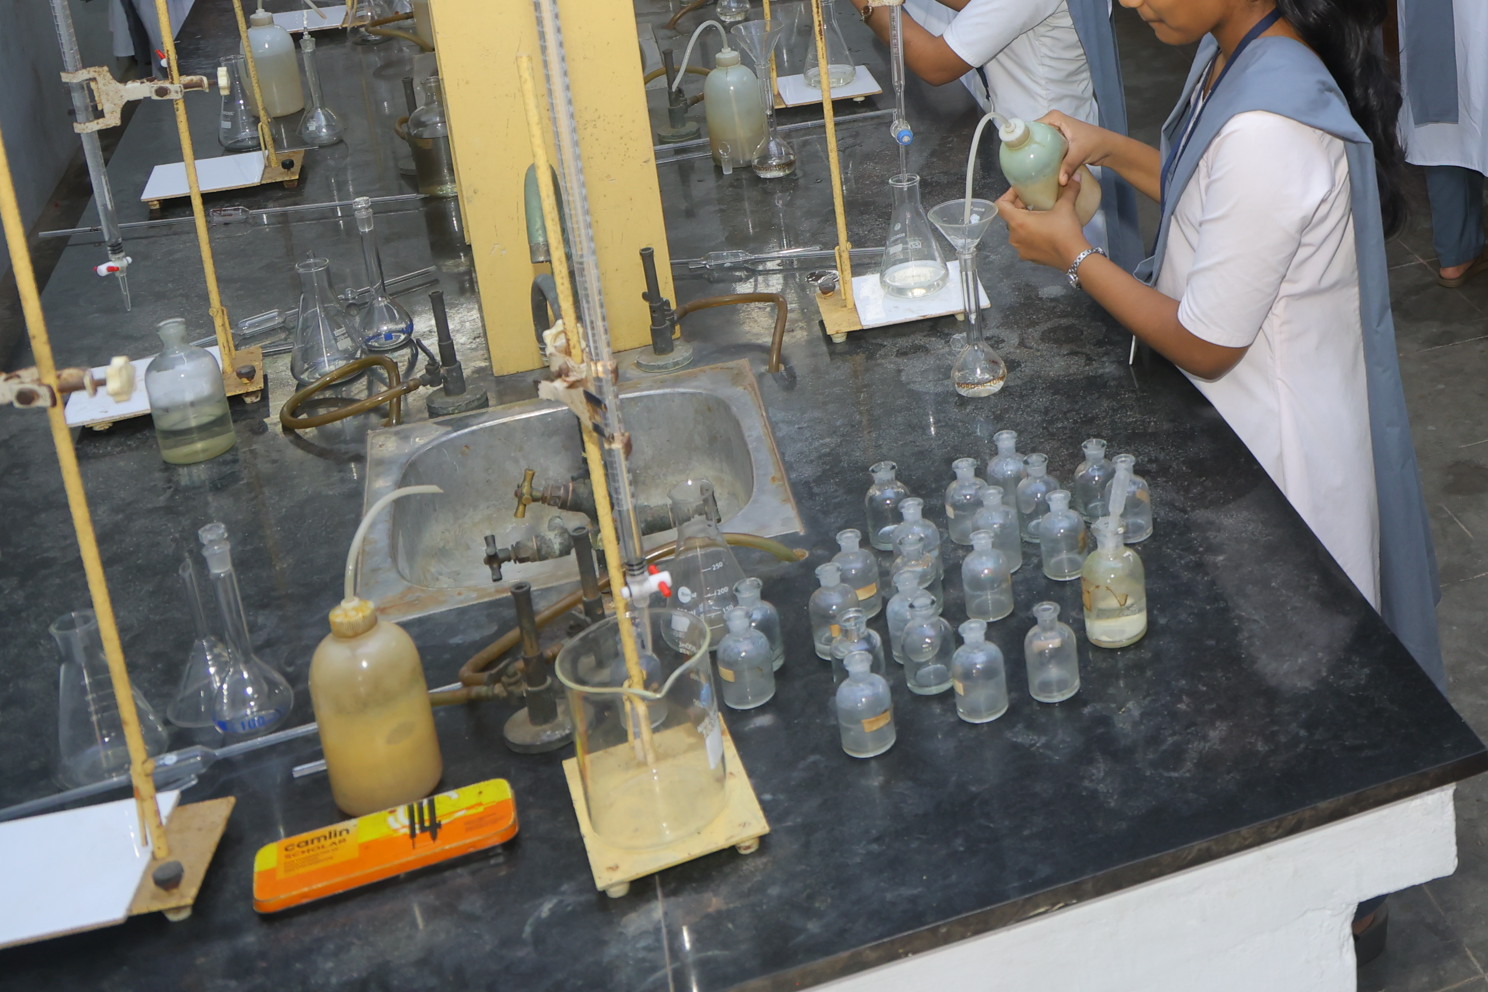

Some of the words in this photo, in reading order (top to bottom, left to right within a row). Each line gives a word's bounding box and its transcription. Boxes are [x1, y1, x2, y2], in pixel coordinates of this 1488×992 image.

[712, 561, 724, 571] 250
[717, 586, 729, 596] 200
[722, 604, 734, 613] 150
[284, 828, 350, 852] camlin
[284, 838, 346, 859] SCHOLAR
